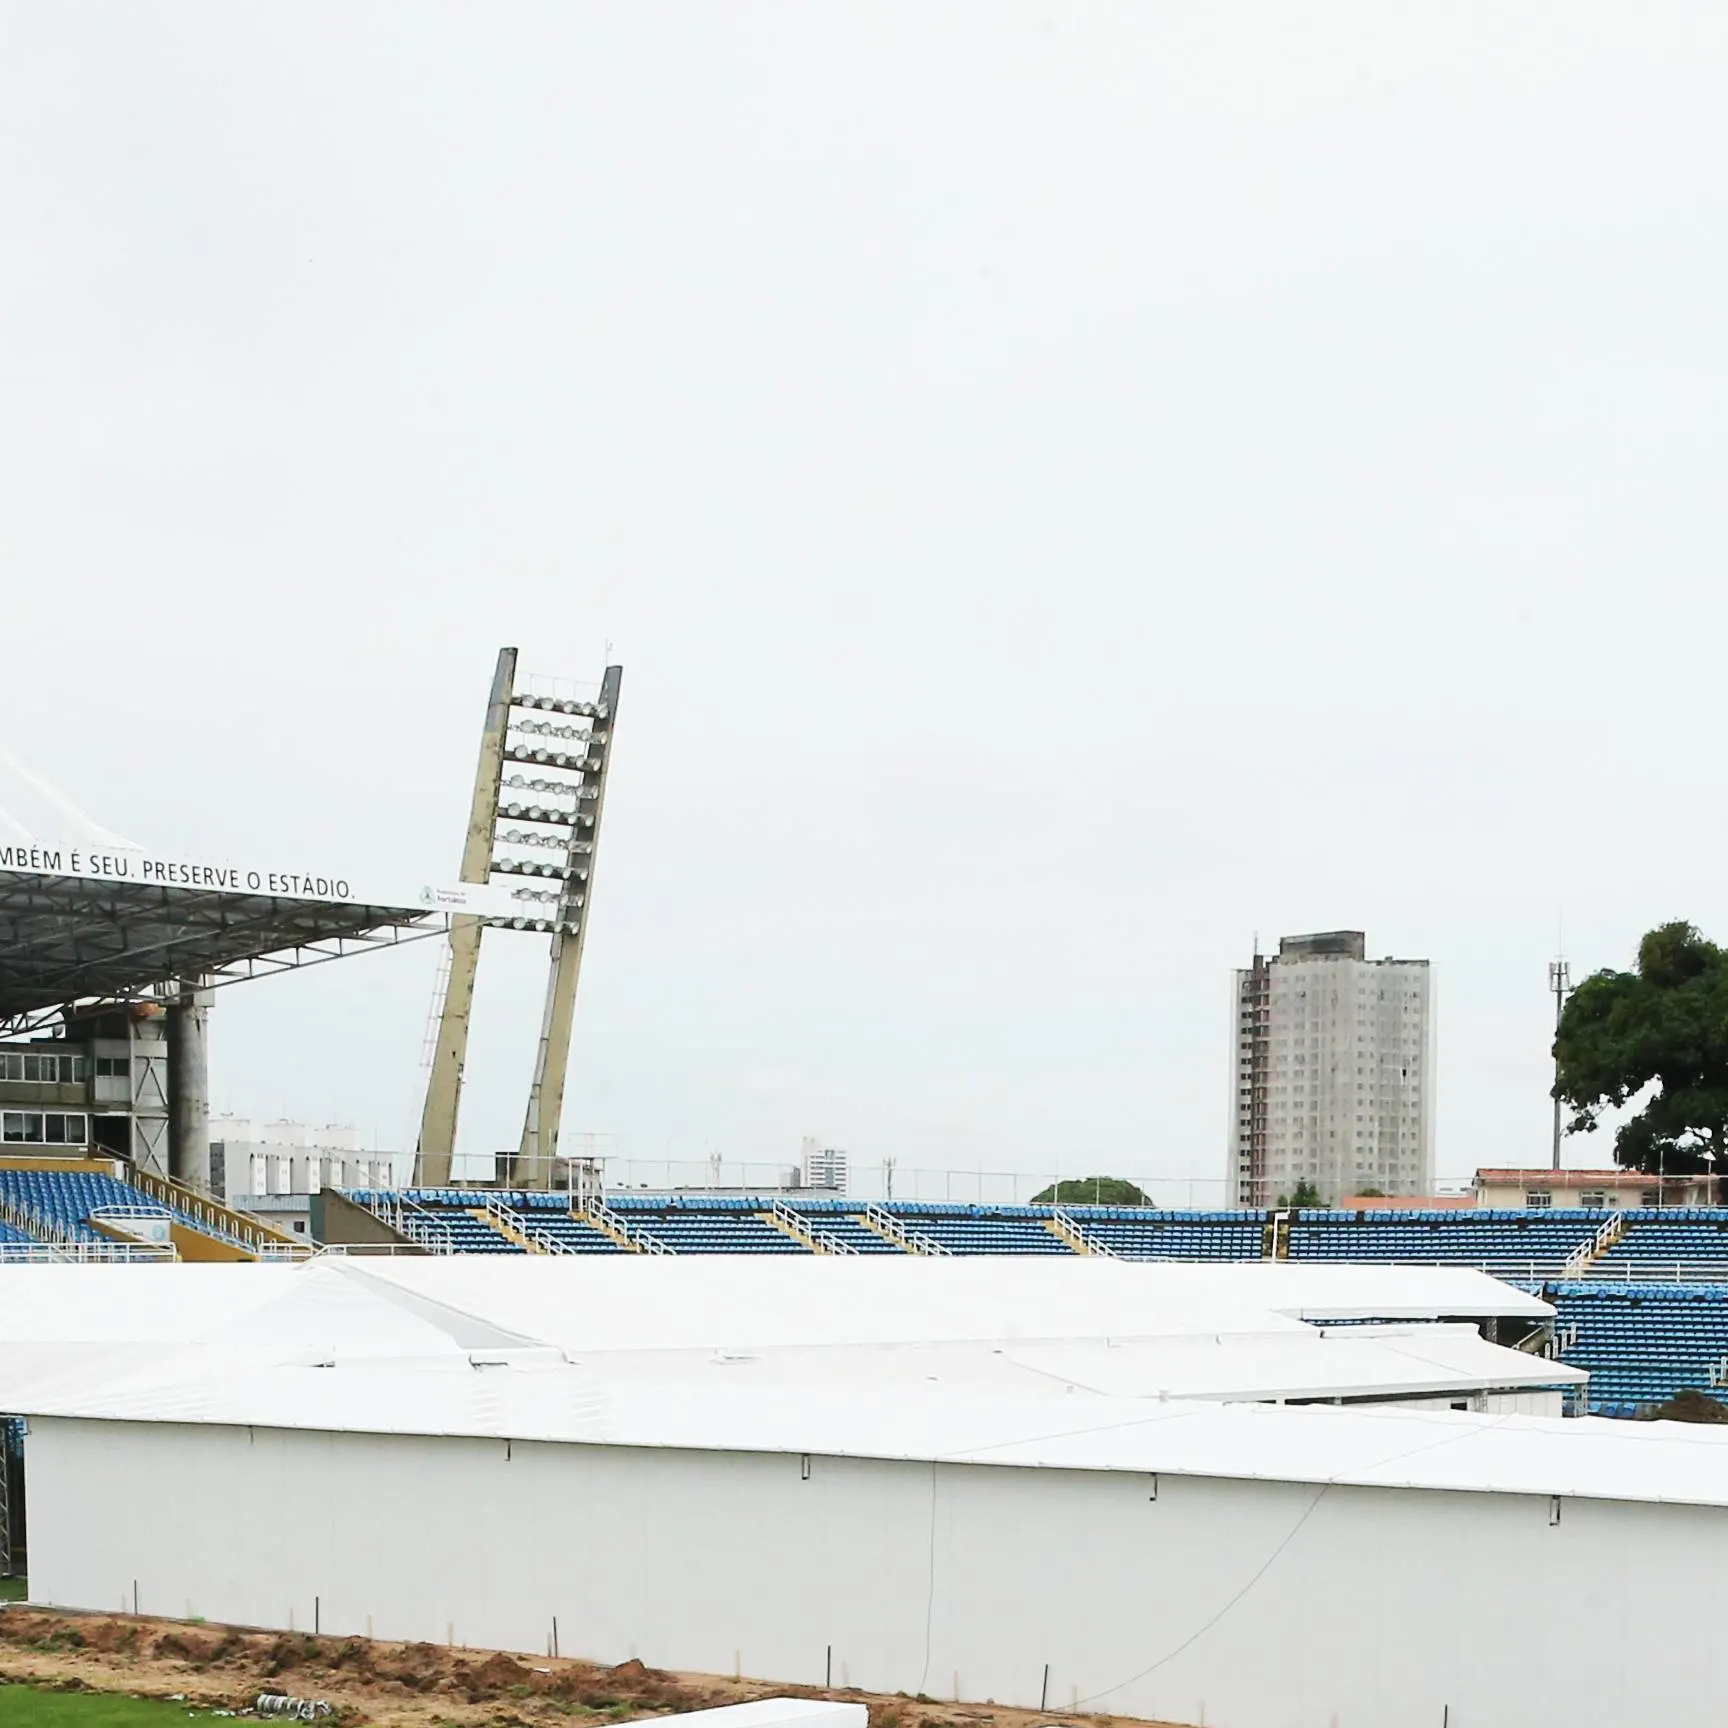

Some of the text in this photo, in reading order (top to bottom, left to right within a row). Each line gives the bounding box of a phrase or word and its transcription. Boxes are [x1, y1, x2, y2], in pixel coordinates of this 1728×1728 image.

[71, 848, 81, 872] É
[90, 855, 135, 877] SEU.
[143, 860, 239, 888] PRESERVE
[247, 871, 261, 890] O
[269, 872, 356, 900] ESTÁDIO.
